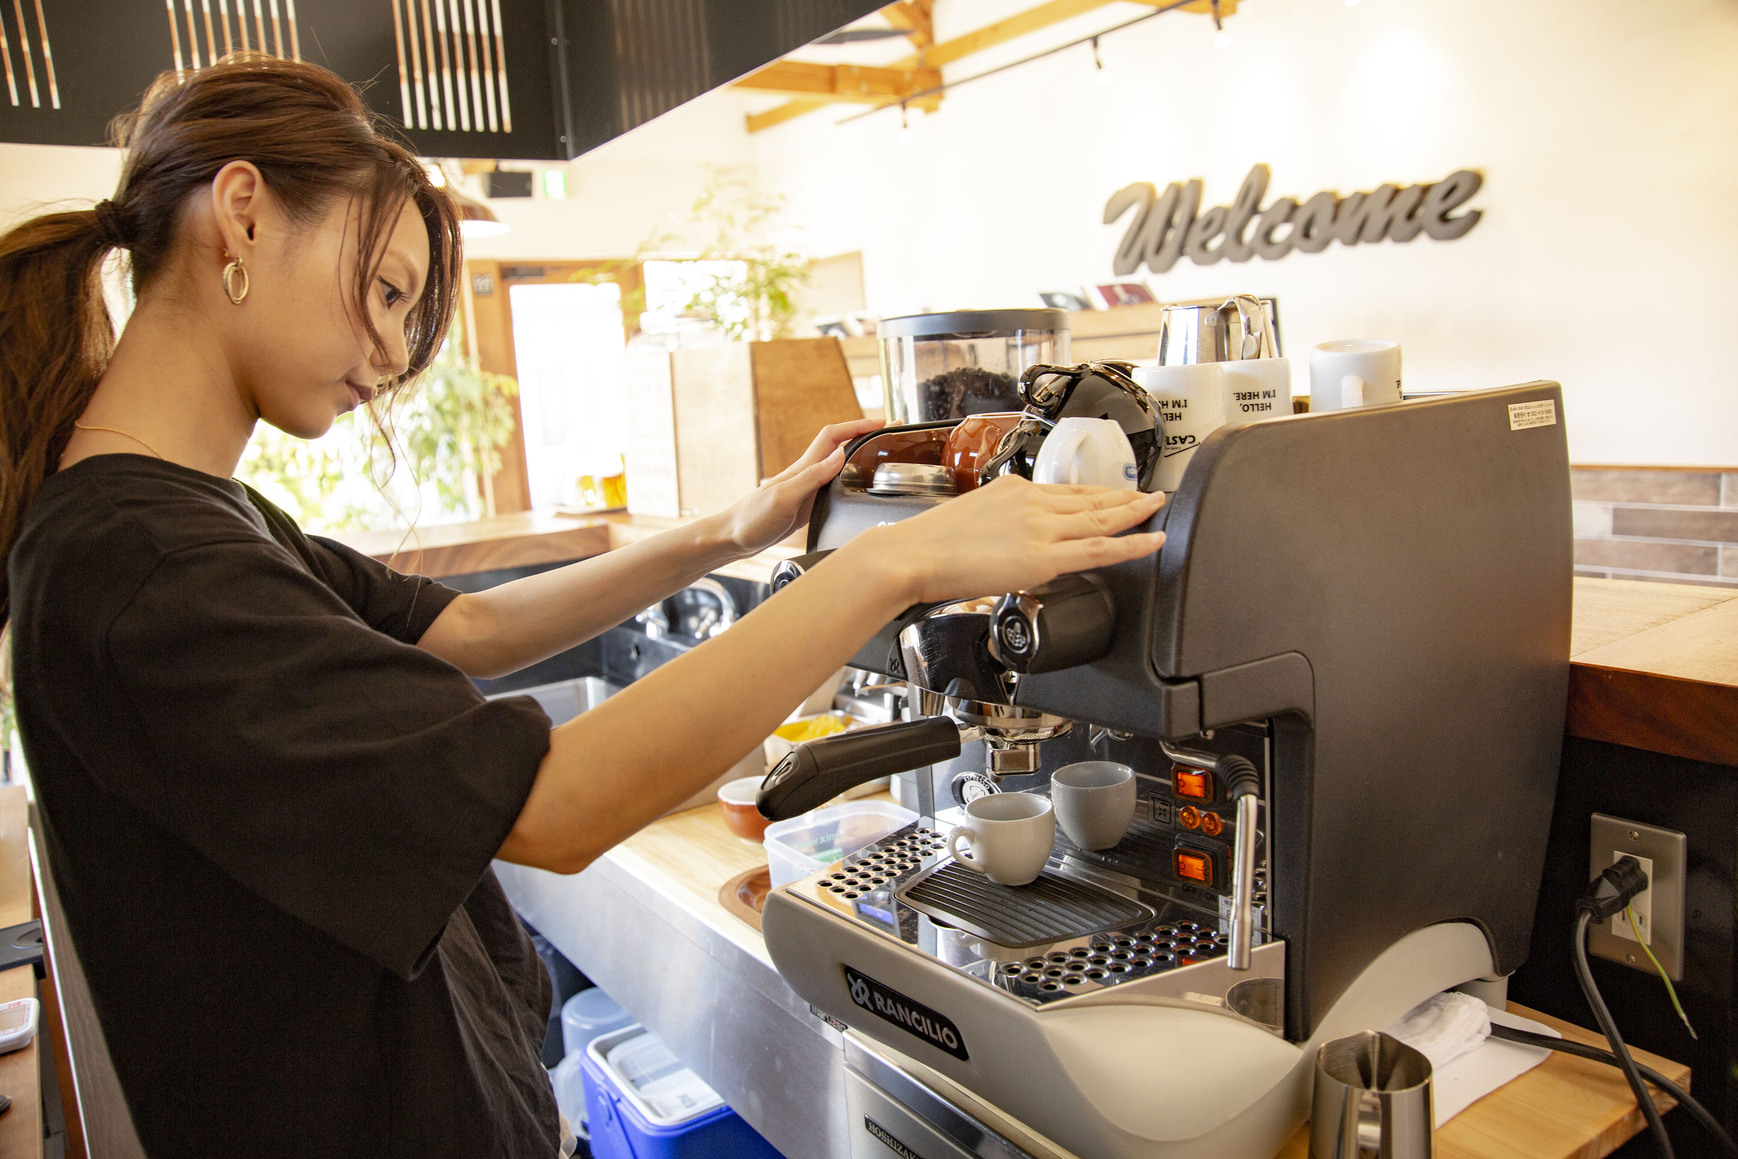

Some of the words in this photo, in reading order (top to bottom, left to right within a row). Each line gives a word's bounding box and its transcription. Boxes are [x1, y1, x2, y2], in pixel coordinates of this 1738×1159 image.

[1103, 163, 1484, 276] Welcome
[1232, 391, 1260, 401] HERE.
[1262, 389, 1276, 399] I'M
[1171, 399, 1188, 409] I'M
[1239, 402, 1272, 413] HELLO,
[1181, 885, 1197, 893] OFF
[1205, 892, 1217, 902] ON
[873, 991, 958, 1049] RANCILIO
[868, 1121, 920, 1159] HOSHIZAK
